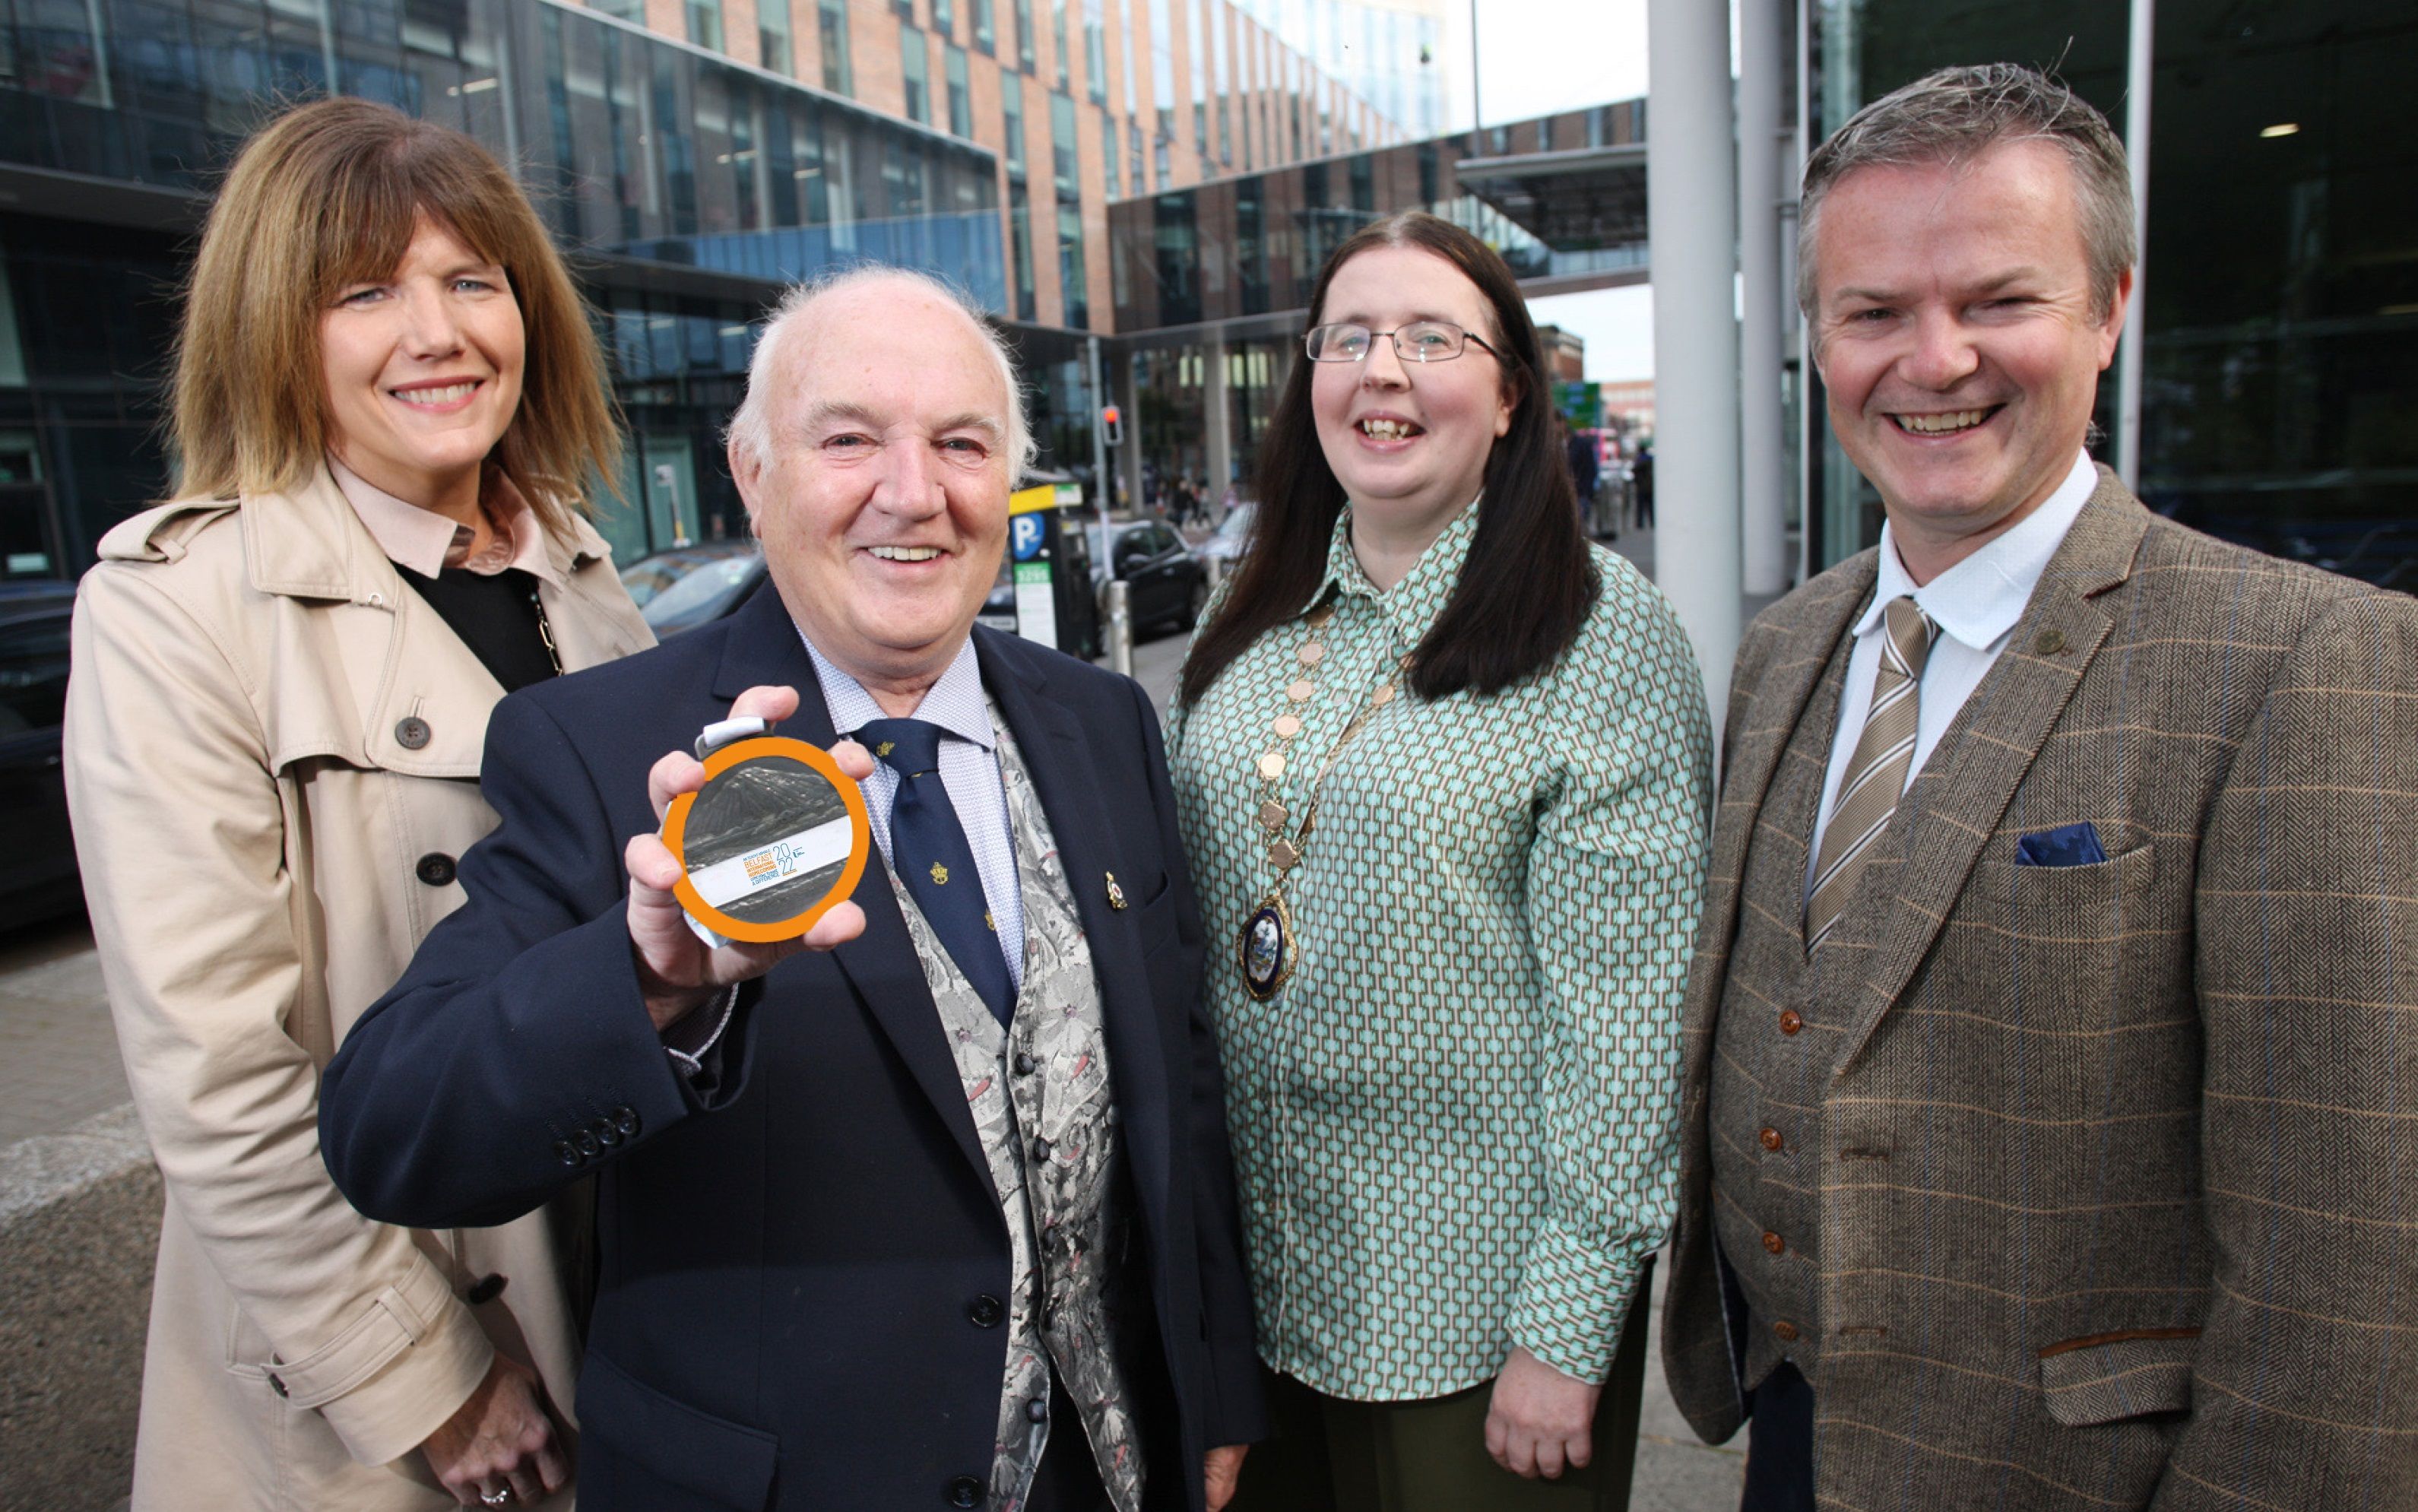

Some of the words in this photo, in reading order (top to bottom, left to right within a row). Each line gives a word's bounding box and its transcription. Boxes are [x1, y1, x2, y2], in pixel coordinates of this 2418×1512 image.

[1015, 517, 1035, 551] P
[744, 853, 772, 868] BELFAST
[773, 843, 791, 861] 20
[749, 864, 776, 877] HOMECOMING
[778, 857, 797, 874] 22
